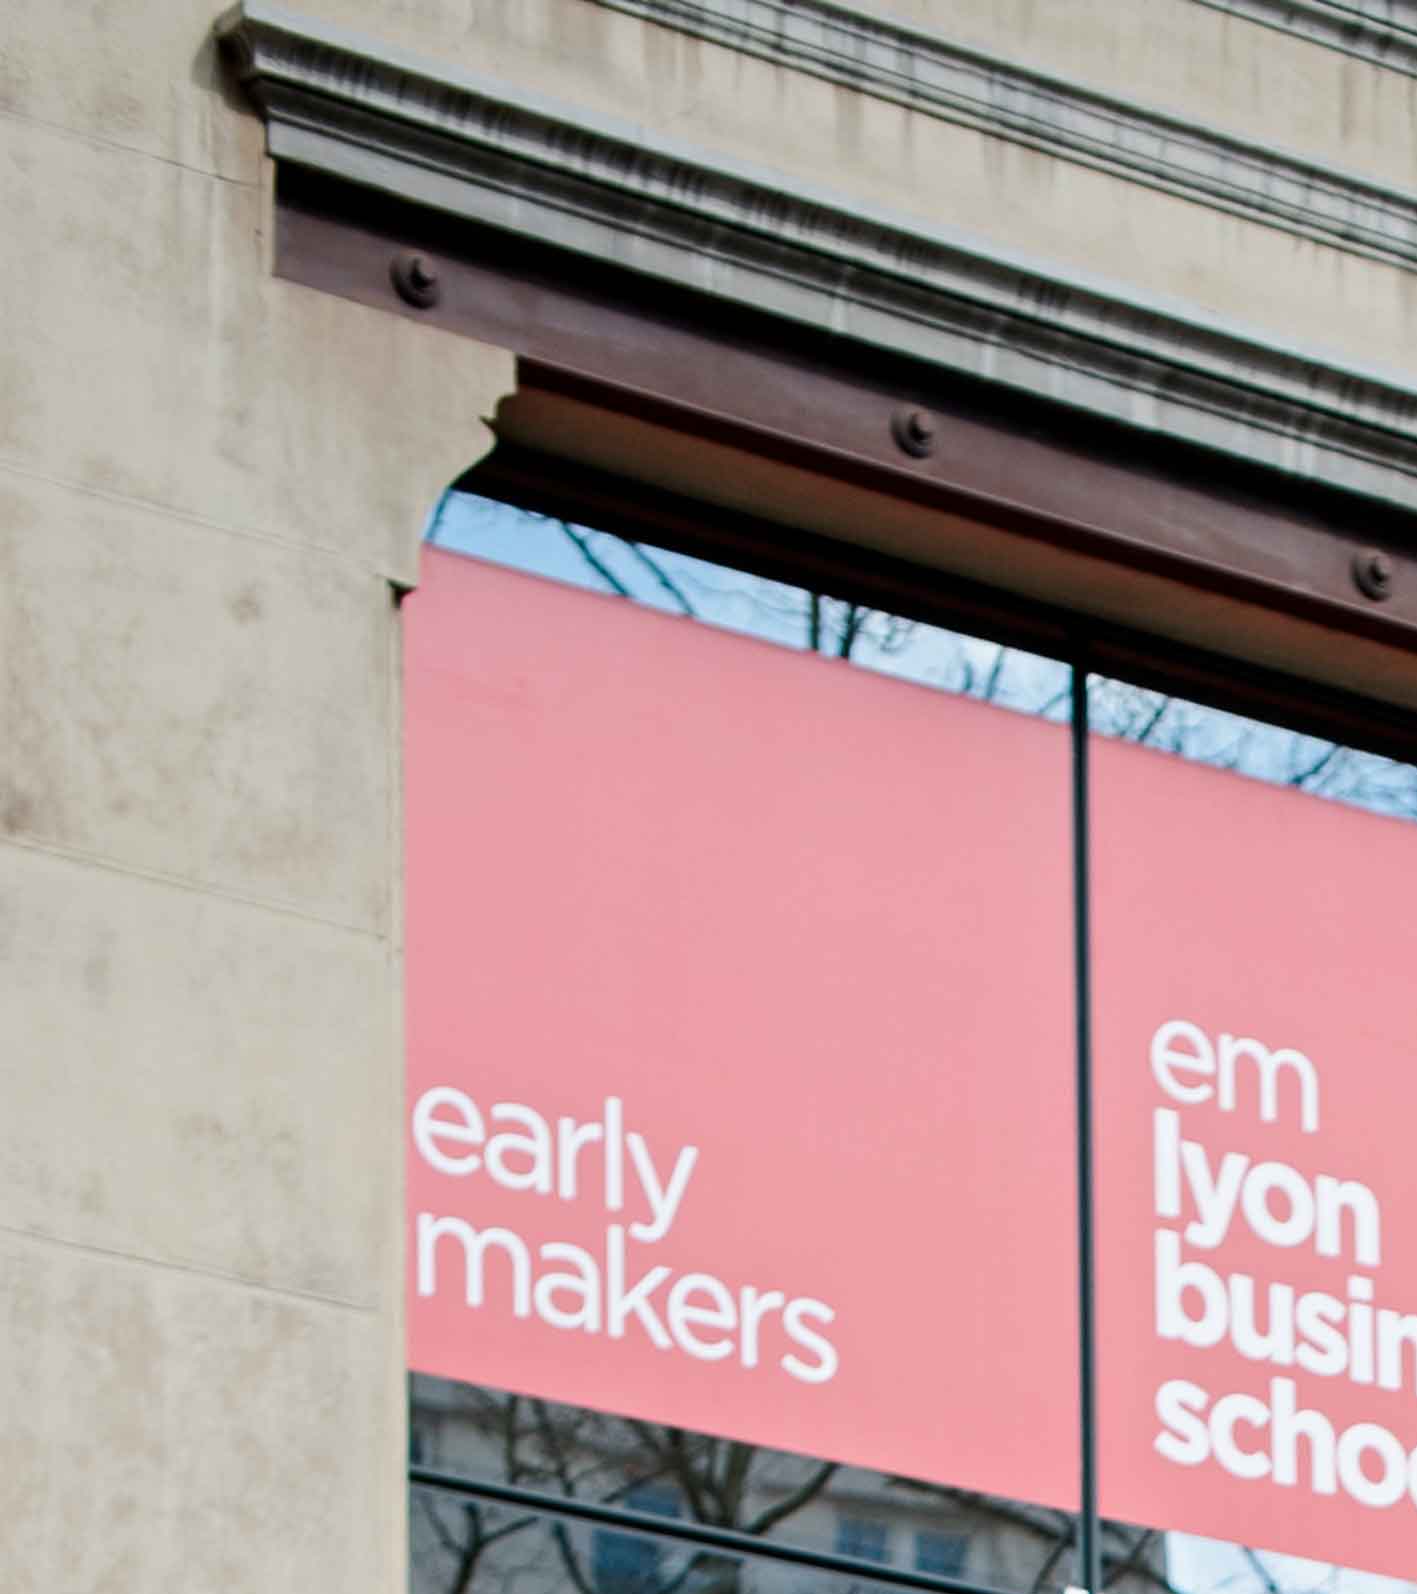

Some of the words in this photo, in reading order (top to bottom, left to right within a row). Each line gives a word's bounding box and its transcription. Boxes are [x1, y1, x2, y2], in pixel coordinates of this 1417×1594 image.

[1150, 1020, 1319, 1133] em
[412, 1086, 699, 1242] early
[1154, 1109, 1380, 1266] lyon
[417, 1212, 839, 1383] makers
